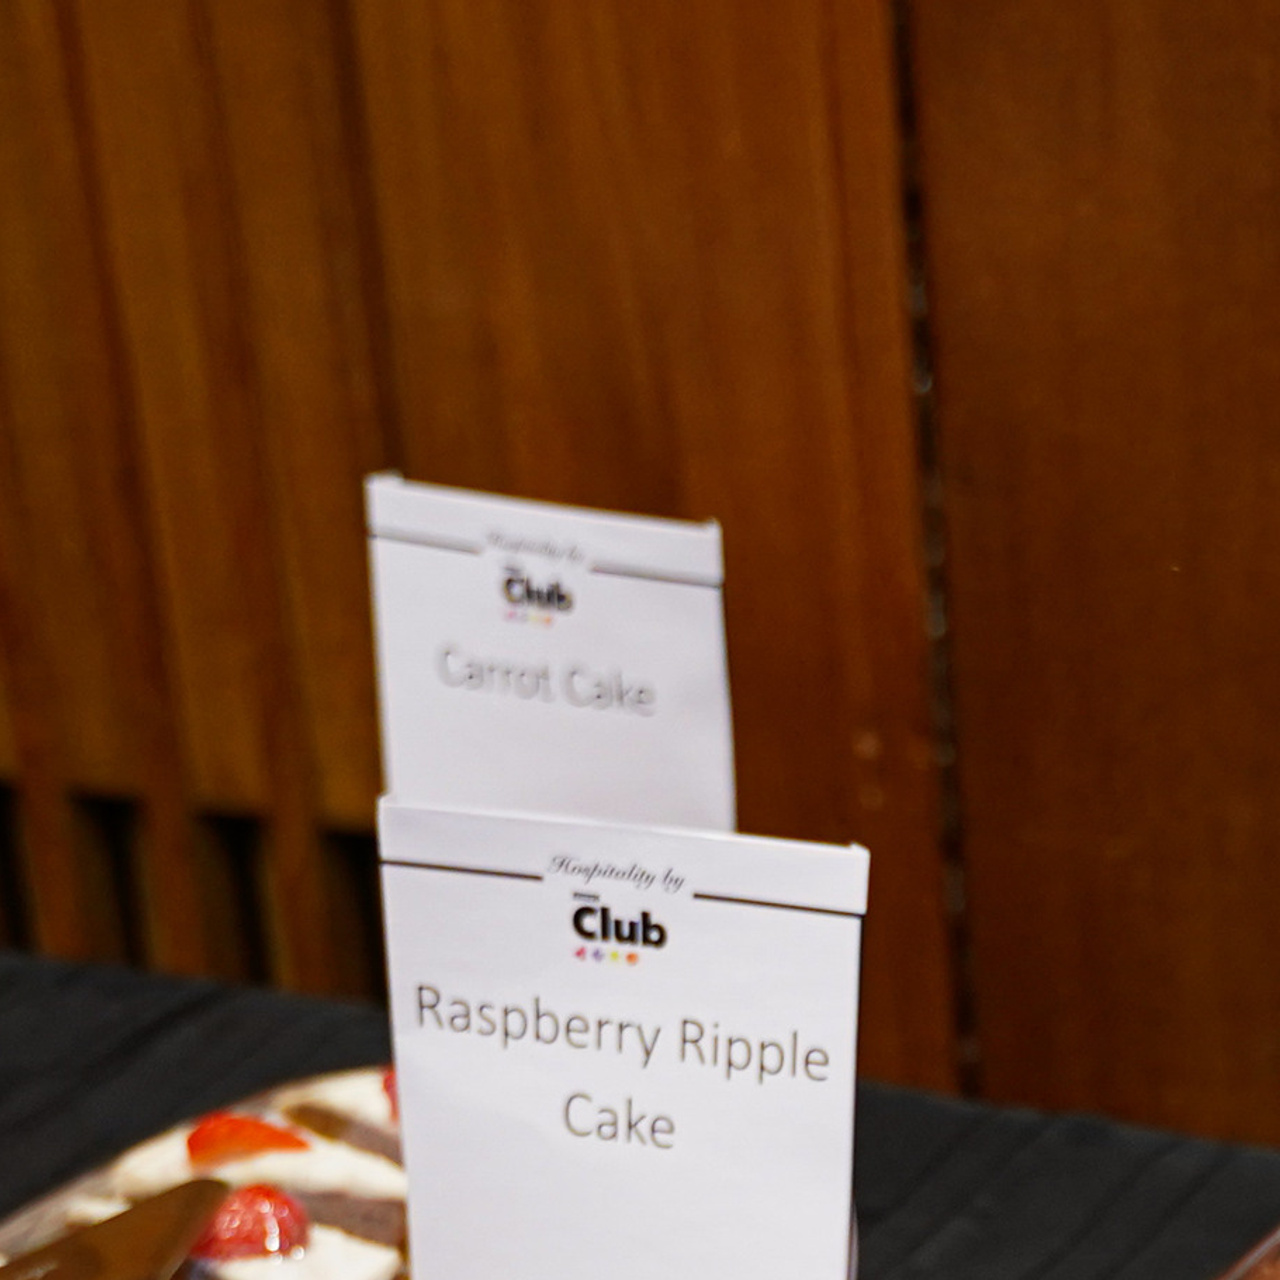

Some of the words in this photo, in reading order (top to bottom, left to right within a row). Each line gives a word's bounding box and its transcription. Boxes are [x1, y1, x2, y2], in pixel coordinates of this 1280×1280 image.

[503, 575, 572, 611] Club
[437, 645, 553, 704] Carrot
[563, 663, 656, 717] Cake
[551, 855, 657, 889] Hospitality
[663, 869, 685, 893] by
[572, 906, 668, 949] Club
[416, 985, 661, 1068] Raspberry
[680, 1019, 829, 1084] Ripple
[564, 1091, 675, 1149] Cake
